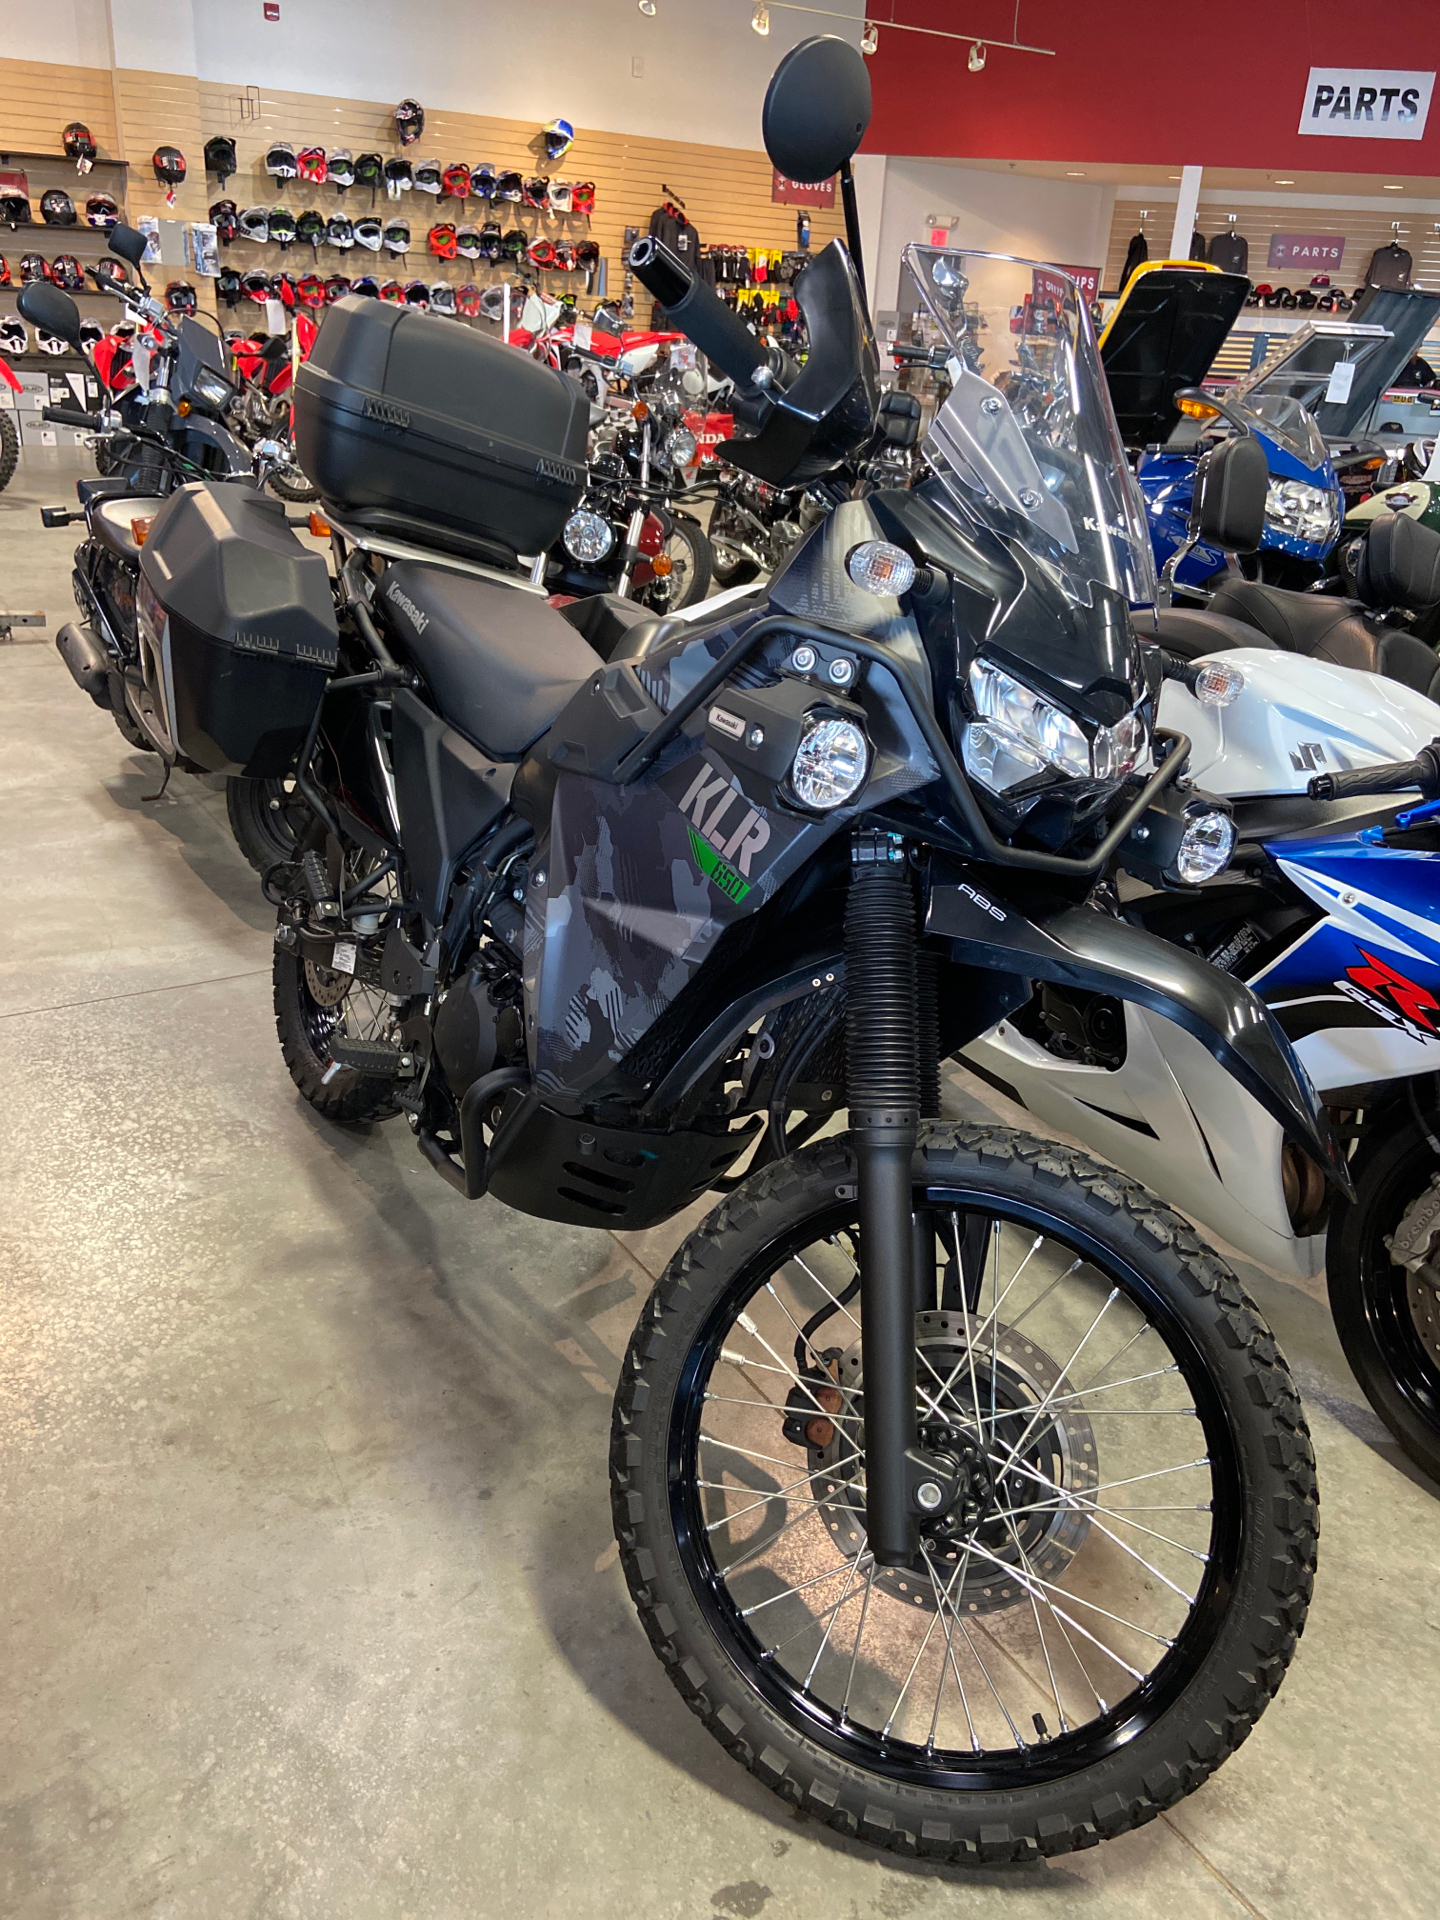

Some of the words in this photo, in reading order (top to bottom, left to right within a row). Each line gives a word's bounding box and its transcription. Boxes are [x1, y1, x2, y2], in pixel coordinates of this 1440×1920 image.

[1311, 84, 1420, 123] PARTS
[792, 181, 832, 192] GLOVES
[1292, 246, 1339, 258] PARTS
[386, 580, 429, 635] Kawasaki
[716, 713, 738, 730] Kawasaki
[677, 762, 771, 878] KLR
[709, 860, 745, 899] 650
[957, 883, 1007, 921] ABS
[1398, 1200, 1440, 1250] brembo
